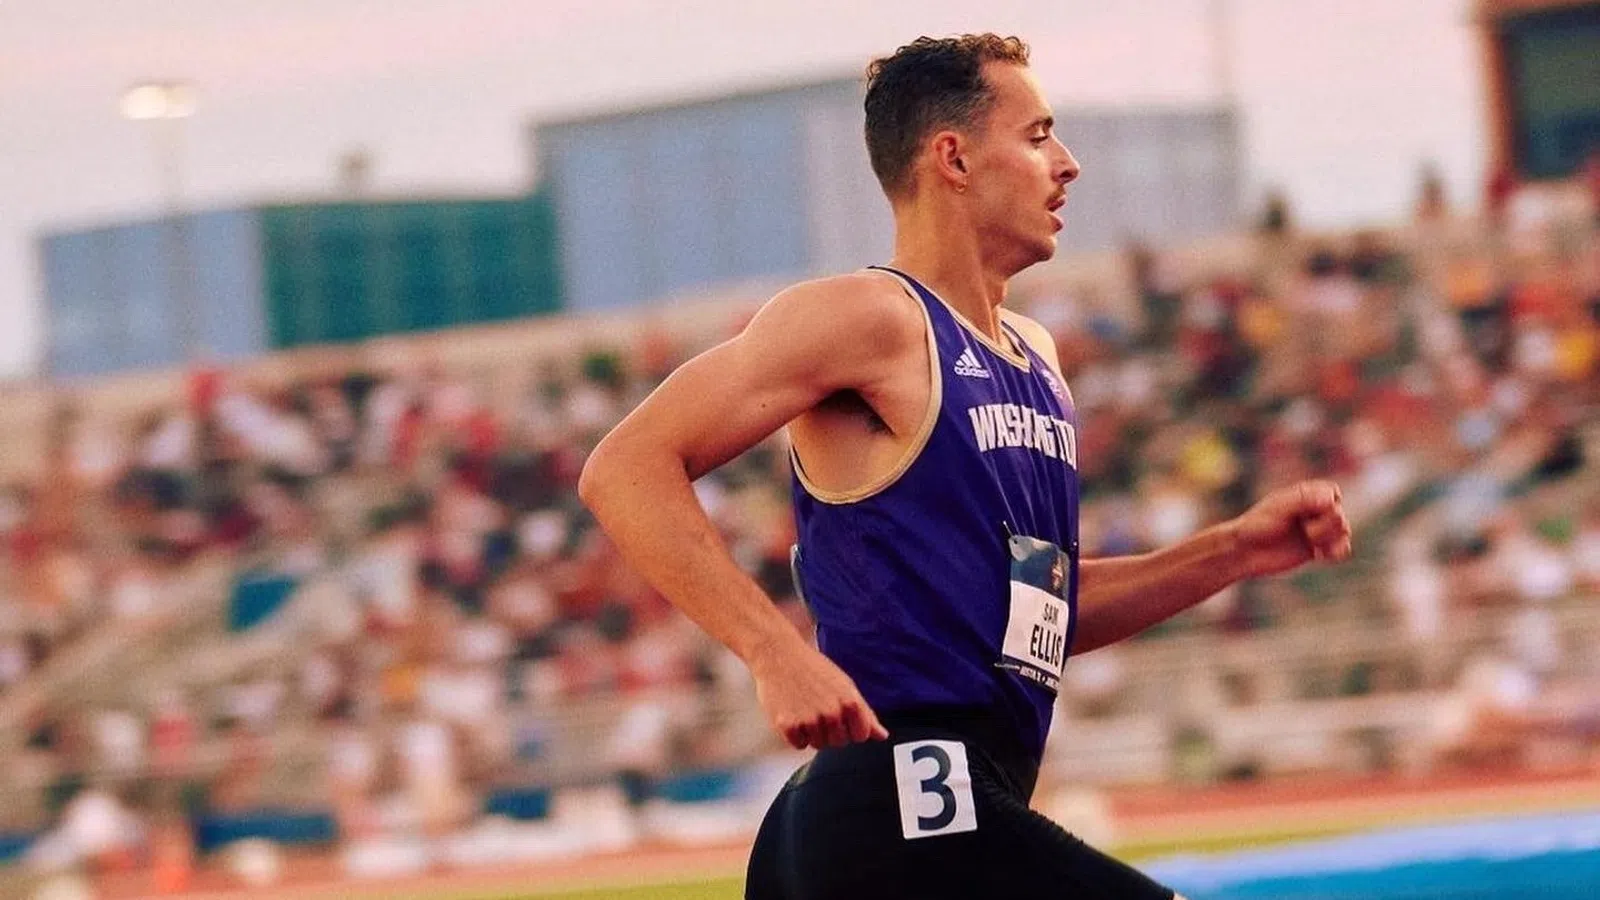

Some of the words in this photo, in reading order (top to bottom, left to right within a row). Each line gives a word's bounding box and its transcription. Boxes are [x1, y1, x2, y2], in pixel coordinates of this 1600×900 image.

[968, 404, 1077, 470] WASHINGTO
[1043, 602, 1059, 625] SAM
[1030, 623, 1062, 667] ELLIS
[912, 745, 957, 831] 3
